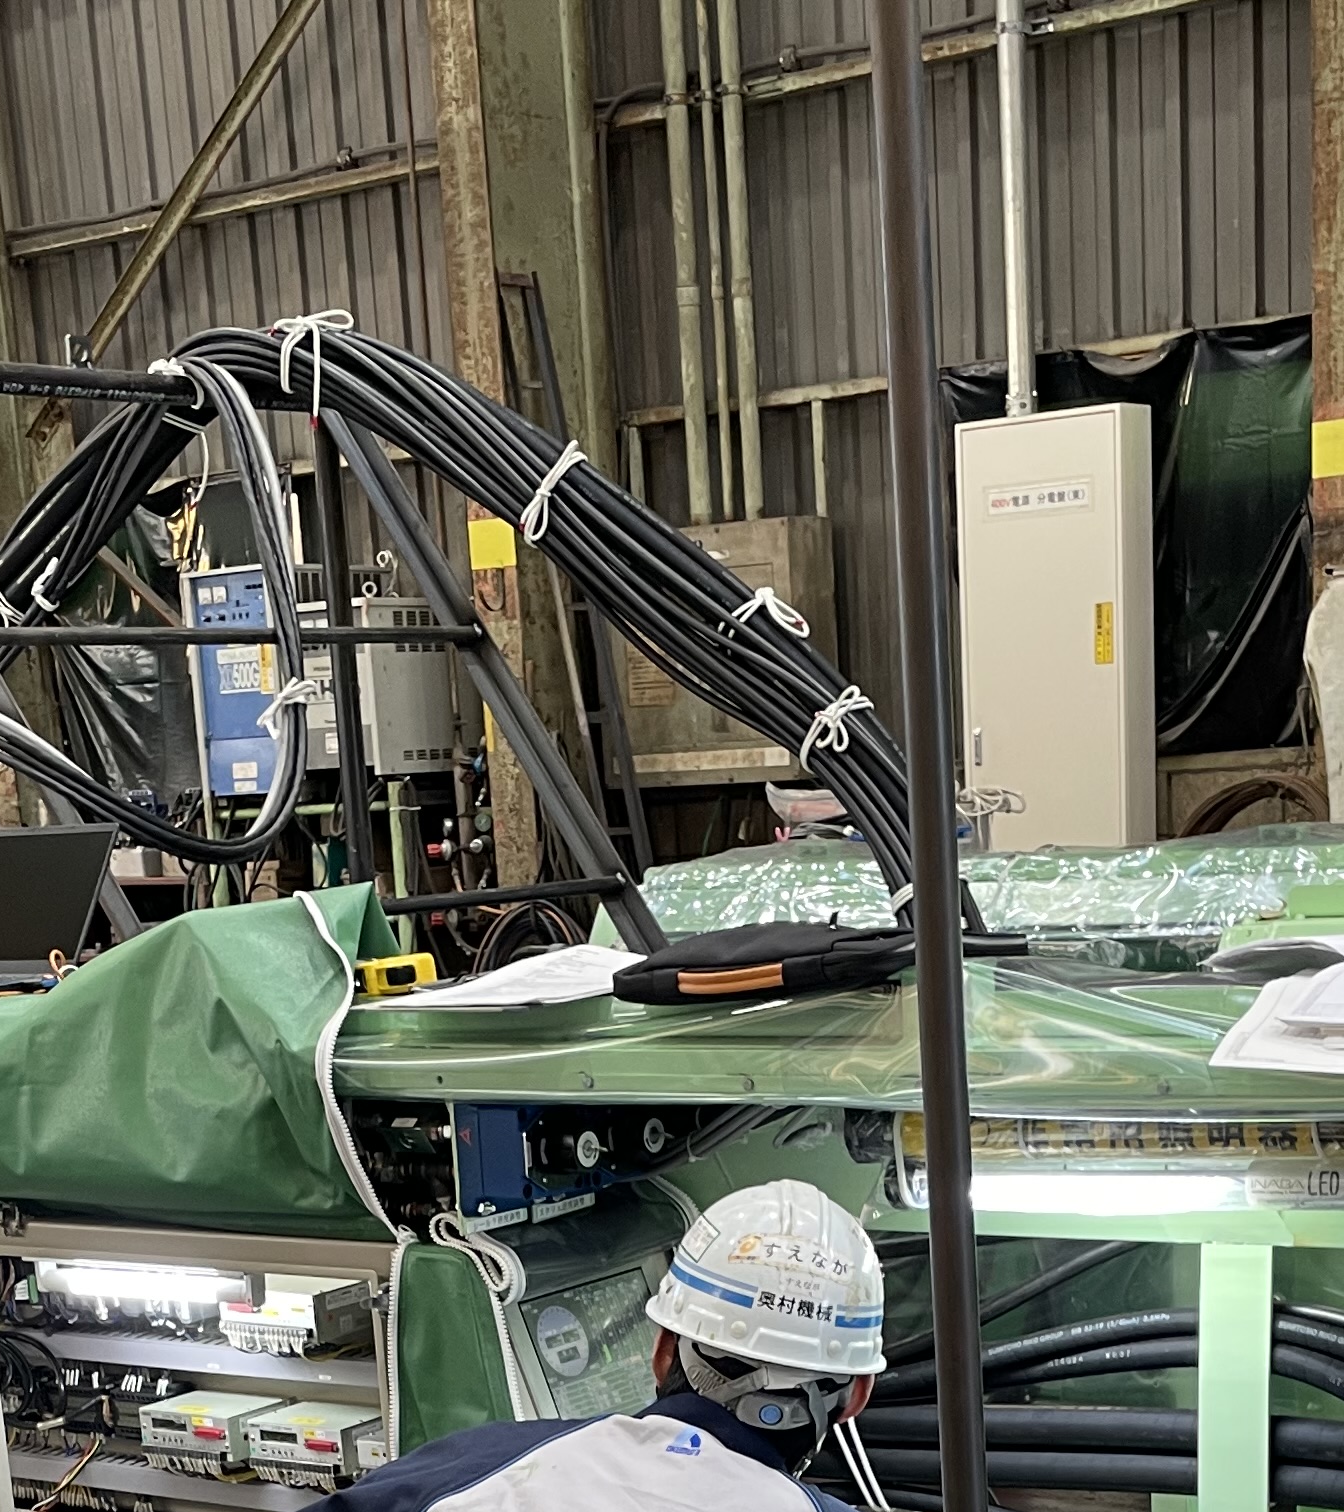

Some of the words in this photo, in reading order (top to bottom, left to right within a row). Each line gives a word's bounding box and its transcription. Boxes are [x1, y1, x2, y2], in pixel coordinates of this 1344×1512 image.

[1250, 1178, 1304, 1194] INABA
[1307, 1170, 1339, 1196] LED
[764, 1243, 849, 1276] すえなが
[757, 1291, 834, 1322] 奥村機械
